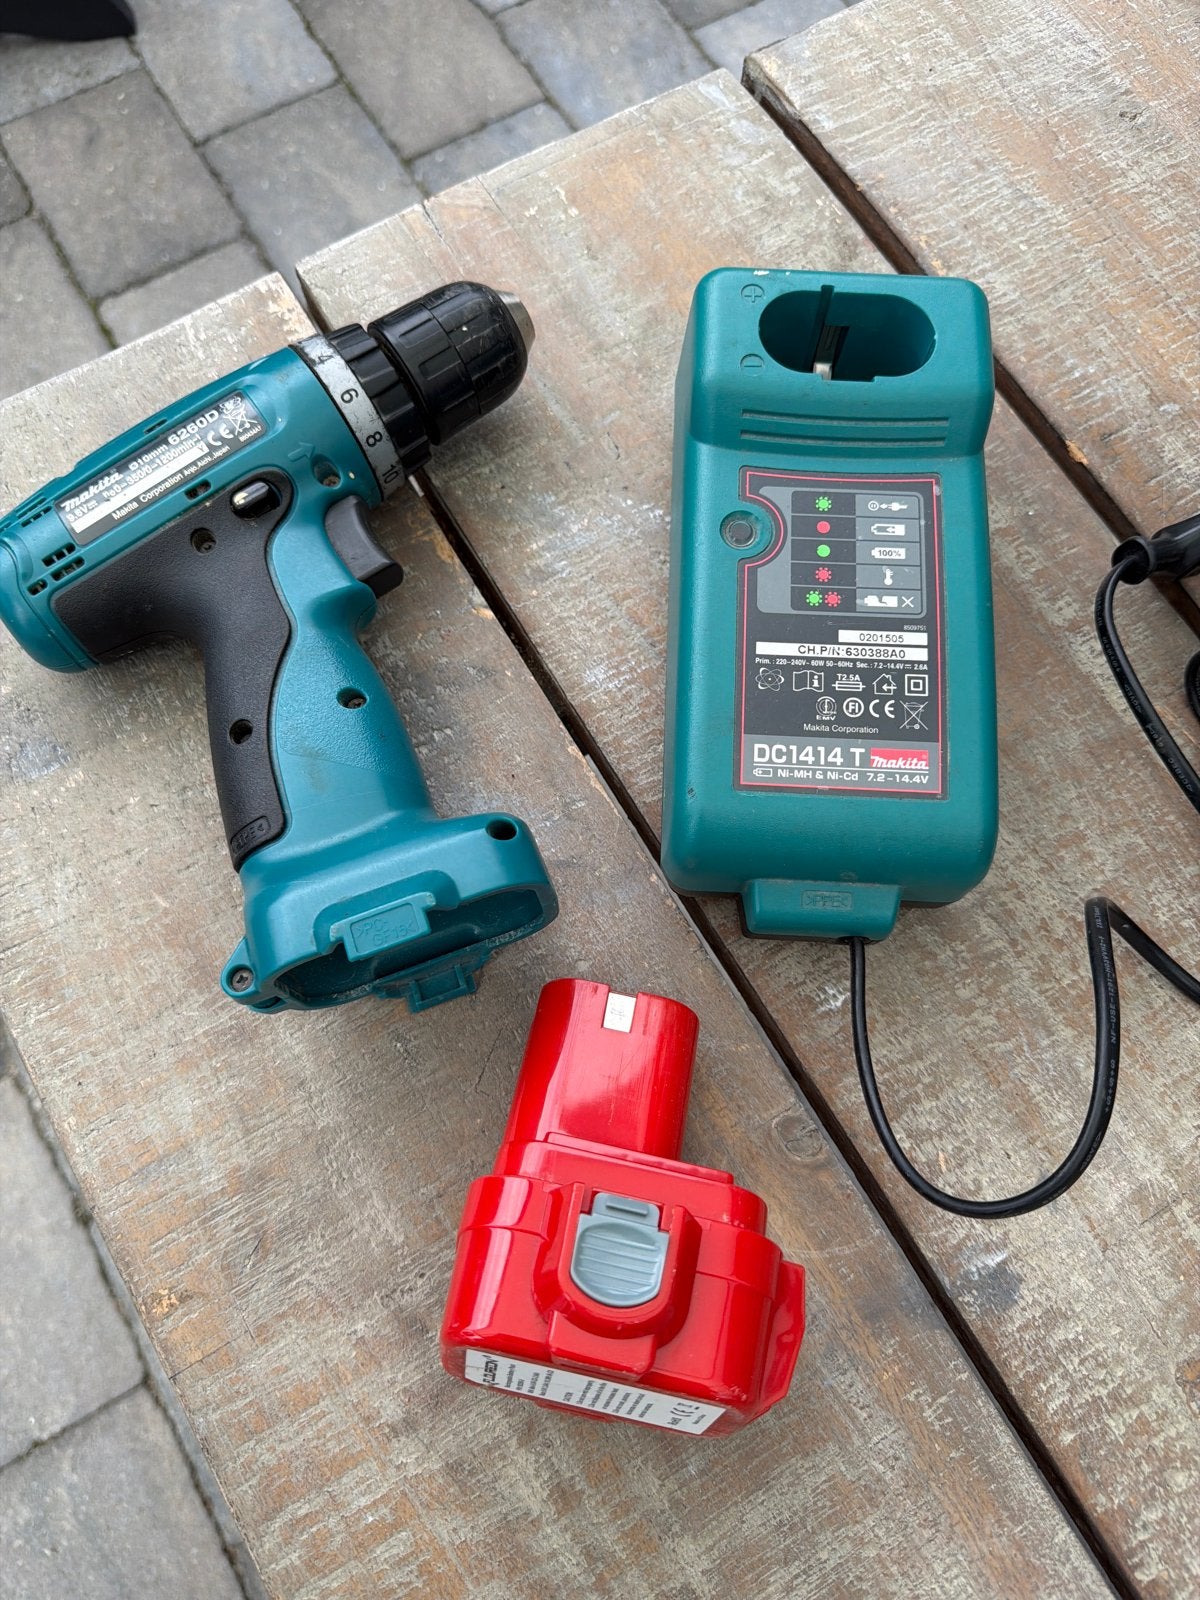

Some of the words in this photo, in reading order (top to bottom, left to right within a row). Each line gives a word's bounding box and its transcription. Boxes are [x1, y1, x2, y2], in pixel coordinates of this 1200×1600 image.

[167, 408, 219, 446] 6260D
[316, 353, 334, 366] 4
[340, 387, 360, 404] 6
[365, 431, 383, 448] 8
[382, 464, 400, 485] 10
[112, 501, 139, 520] Makita
[140, 474, 184, 504] Corporation
[877, 549, 902, 558] 100%
[858, 633, 905, 643] 0201505
[868, 699, 896, 719] CE
[803, 723, 830, 733] Makita
[831, 724, 879, 735] Corporation
[753, 743, 844, 767] DC1414
[850, 748, 866, 767] T
[777, 768, 813, 779] Ni-MH
[815, 770, 824, 779] &
[827, 771, 859, 781] Ni-Cd
